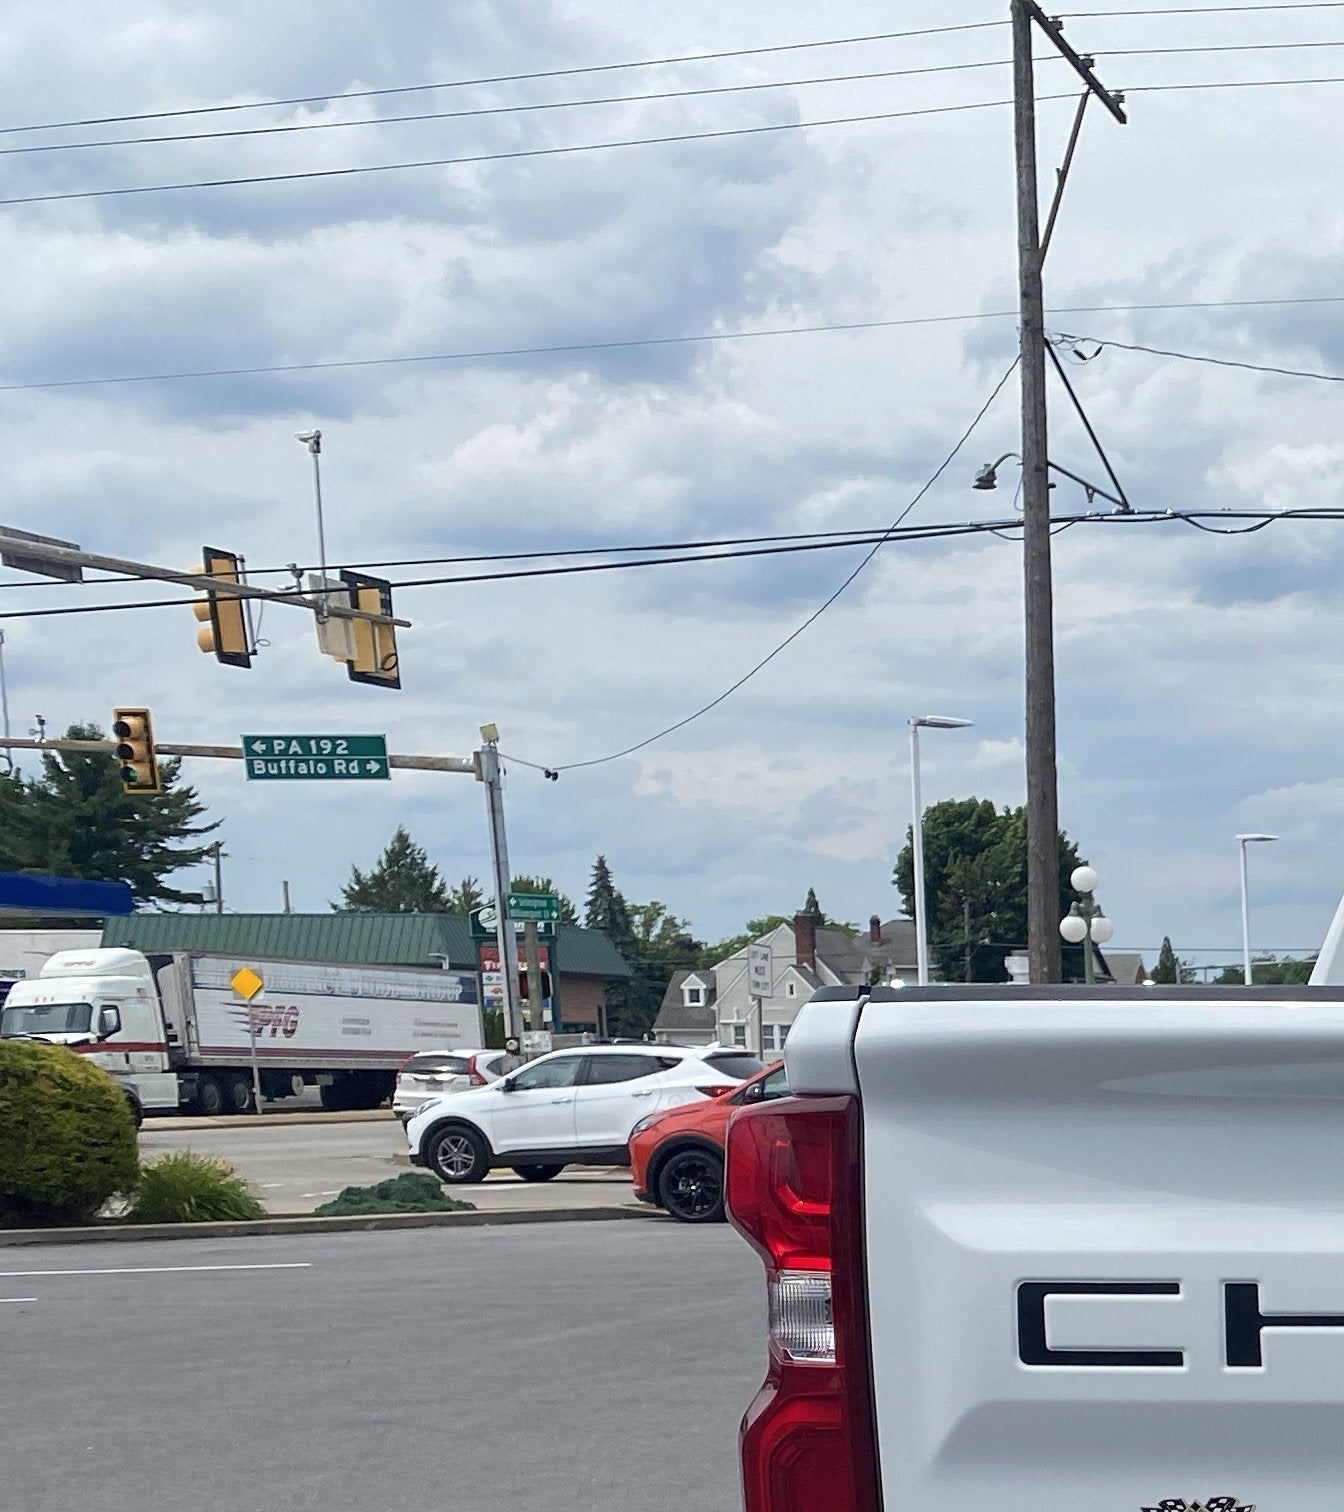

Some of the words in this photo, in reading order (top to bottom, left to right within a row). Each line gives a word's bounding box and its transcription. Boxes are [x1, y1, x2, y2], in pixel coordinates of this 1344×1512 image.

[272, 739, 303, 755] PA
[309, 739, 349, 755] 192
[253, 759, 327, 775] Buffalo
[333, 759, 360, 775] Rd
